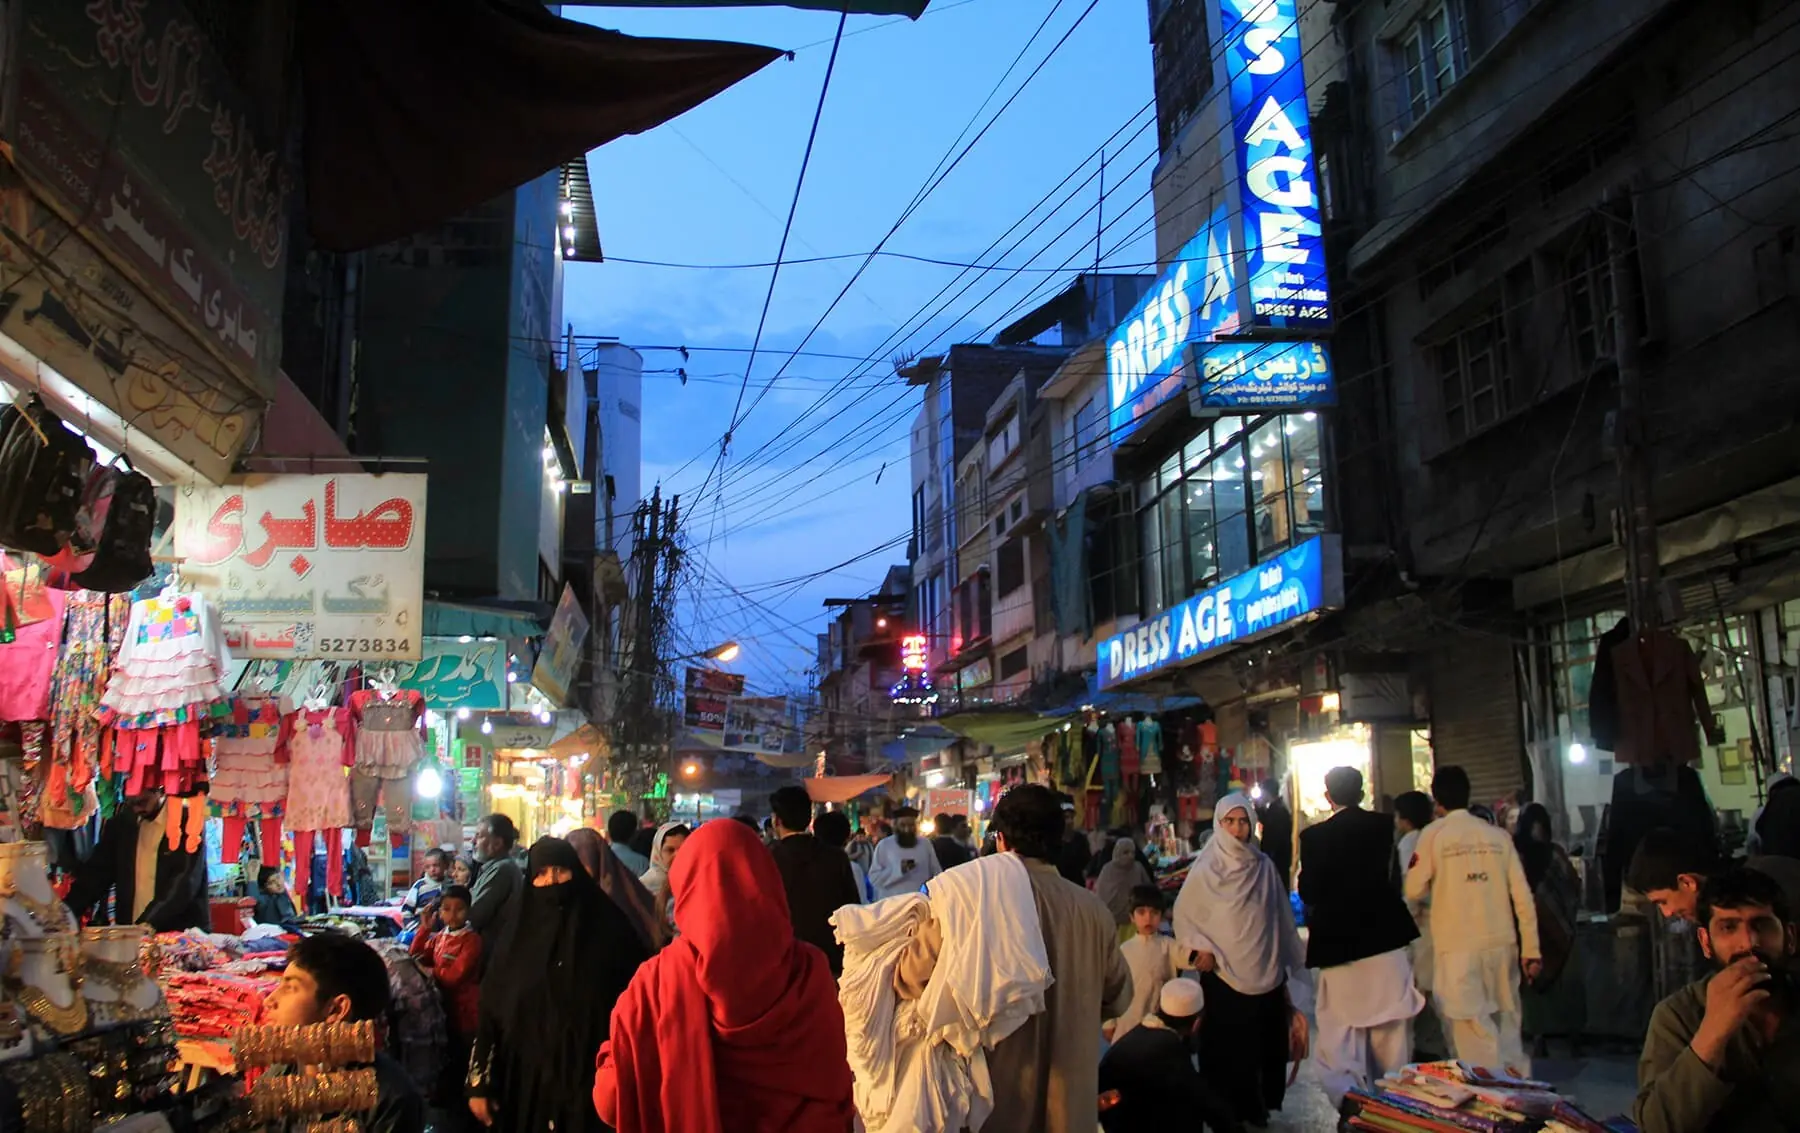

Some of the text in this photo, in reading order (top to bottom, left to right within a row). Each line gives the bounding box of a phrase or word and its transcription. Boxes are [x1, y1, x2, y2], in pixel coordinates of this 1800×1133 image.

[1244, 95, 1312, 265] AGE
[1255, 303, 1295, 317] DRESS
[1110, 262, 1191, 409] DRESS
[1254, 342, 1328, 381] ڈریس
[184, 478, 416, 577] صابری
[319, 637, 411, 654] 5273834
[1110, 588, 1233, 679] DRESS AGE
[438, 679, 484, 708] کتب
[505, 731, 542, 747] روشن
